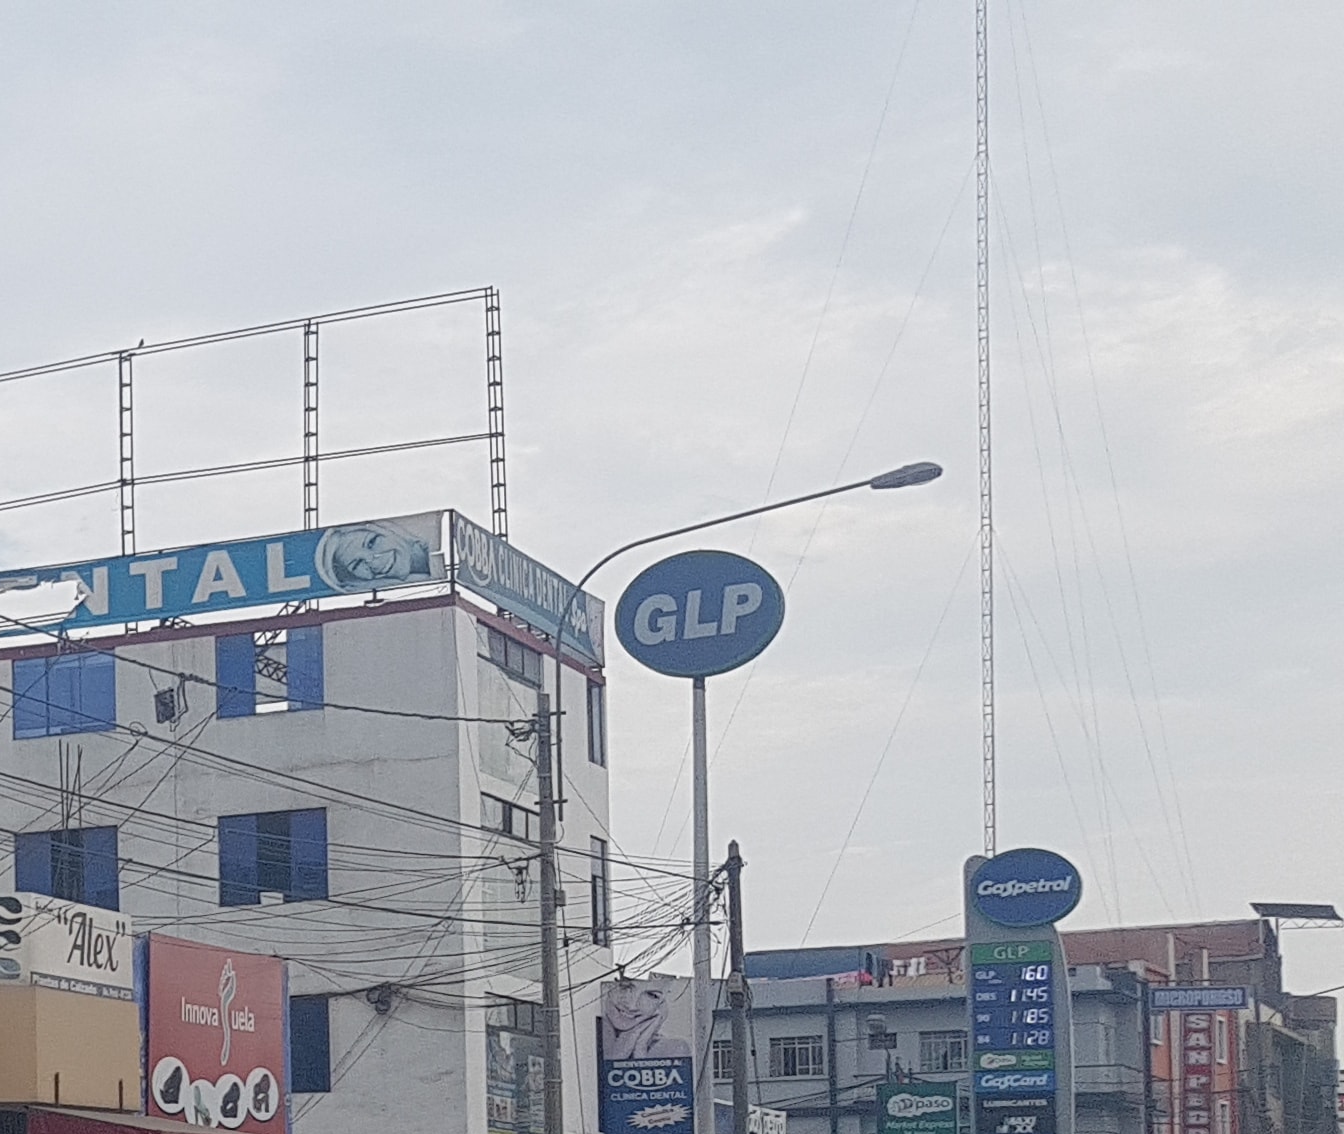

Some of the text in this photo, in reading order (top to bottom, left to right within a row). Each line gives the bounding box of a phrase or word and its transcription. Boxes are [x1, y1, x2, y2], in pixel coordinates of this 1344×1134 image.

[457, 518, 497, 586] COBBA
[498, 545, 535, 604] CLINICA
[634, 582, 763, 646] GLP
[977, 876, 1072, 897] Gaspetrol
[994, 946, 1030, 960] GLP
[975, 971, 996, 980] GLP
[182, 997, 219, 1026] Innova
[976, 1014, 990, 1023] 90
[608, 1069, 684, 1090] COBBA
[611, 1091, 687, 1101] CLINICA DENTAL
